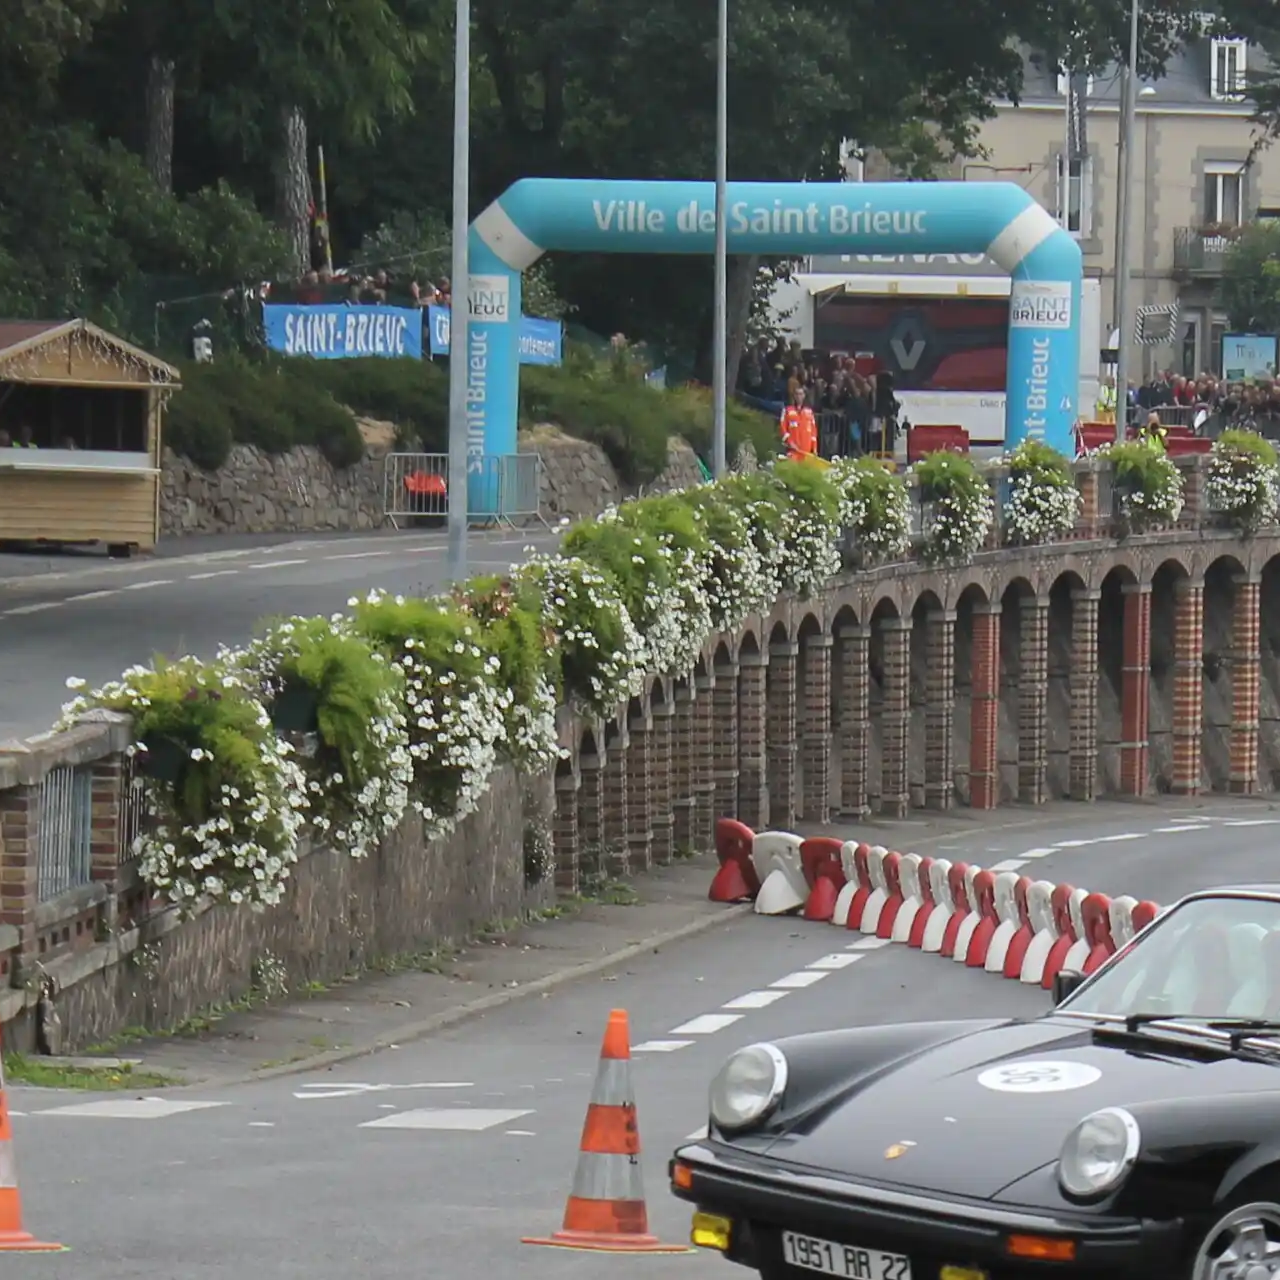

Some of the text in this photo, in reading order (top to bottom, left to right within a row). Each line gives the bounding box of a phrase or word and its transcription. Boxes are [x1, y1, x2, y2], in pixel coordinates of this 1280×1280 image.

[592, 198, 664, 233] Ville
[676, 199, 717, 233] de
[1012, 310, 1068, 322] BRIEUC
[1013, 296, 1071, 310] SAINT
[284, 313, 407, 355] SAINT-BRIEUC
[787, 1234, 834, 1273] 1951
[843, 1247, 872, 1280] RR
